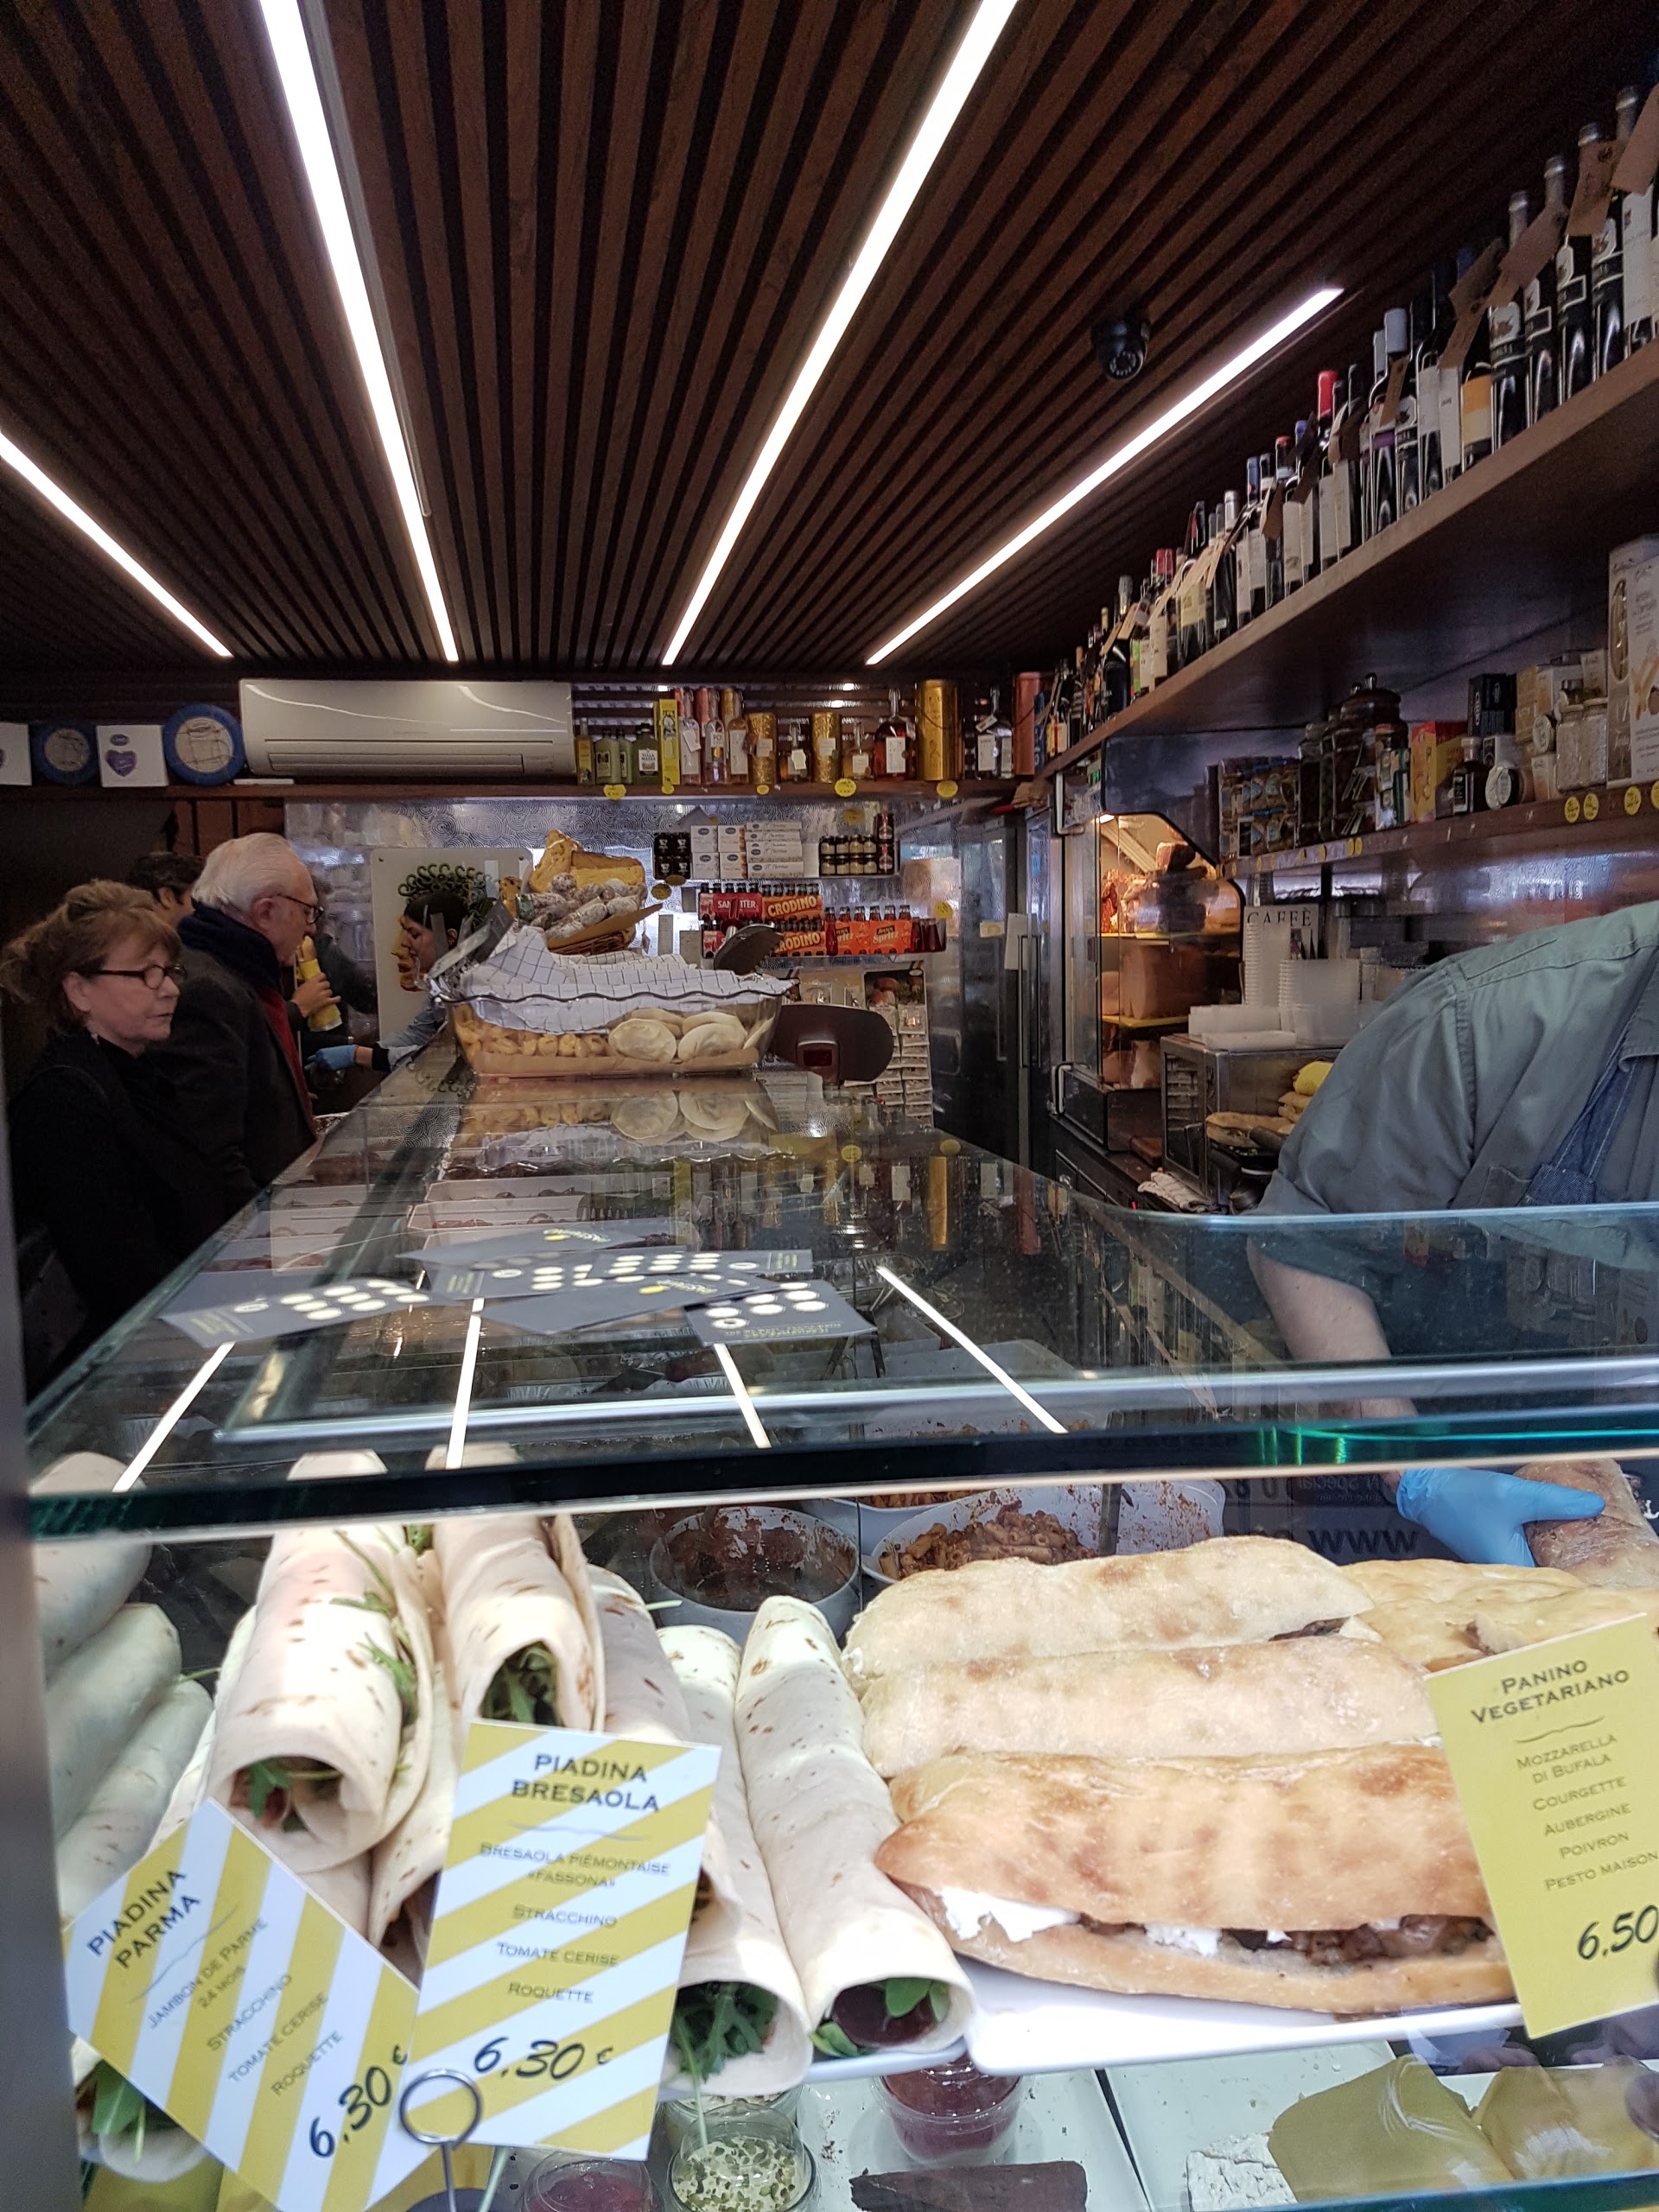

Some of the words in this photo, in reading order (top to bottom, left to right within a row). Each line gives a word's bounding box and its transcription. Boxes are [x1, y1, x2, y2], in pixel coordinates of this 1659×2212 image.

[767, 895, 817, 918] CRODINO
[775, 932, 821, 954] RODINO
[873, 931, 899, 944] Spritz
[1500, 1660, 1587, 1694] PANINO
[1471, 1669, 1630, 1723] VEGETARIANO
[534, 1752, 647, 1783] PIADINA
[1516, 1733, 1618, 1770] MOZZARELLA
[1533, 1771, 1548, 1784] DI
[1553, 1753, 1611, 1777] BUFALA
[512, 1779, 659, 1811] BRESAOLA
[1533, 1777, 1627, 1811] COURGETTE
[1544, 1802, 1631, 1836] AUBERGINE
[480, 1841, 565, 1864] BRESAOLA
[1559, 1832, 1630, 1858] POIVRON
[1544, 1869, 1597, 1891] PESTO
[1600, 1851, 1659, 1875] MAISON
[86, 1869, 188, 1957] PIADINA
[512, 1904, 618, 1929] STRACCHINO
[114, 1895, 200, 1969] PARMA
[497, 1942, 561, 1961] TOMATE
[564, 1948, 620, 1967] CERISE
[148, 1976, 204, 2030] JAMBON
[200, 1959, 222, 1980] DE
[219, 1917, 269, 1961] PARME
[198, 1989, 217, 2010] 24
[508, 1980, 594, 2004] ROQUETTE
[207, 1974, 293, 2052] STRACCHINO
[228, 2033, 284, 2083] TOMATE
[280, 1990, 329, 2037] CERISE
[270, 2030, 344, 2097] ROQUETTE
